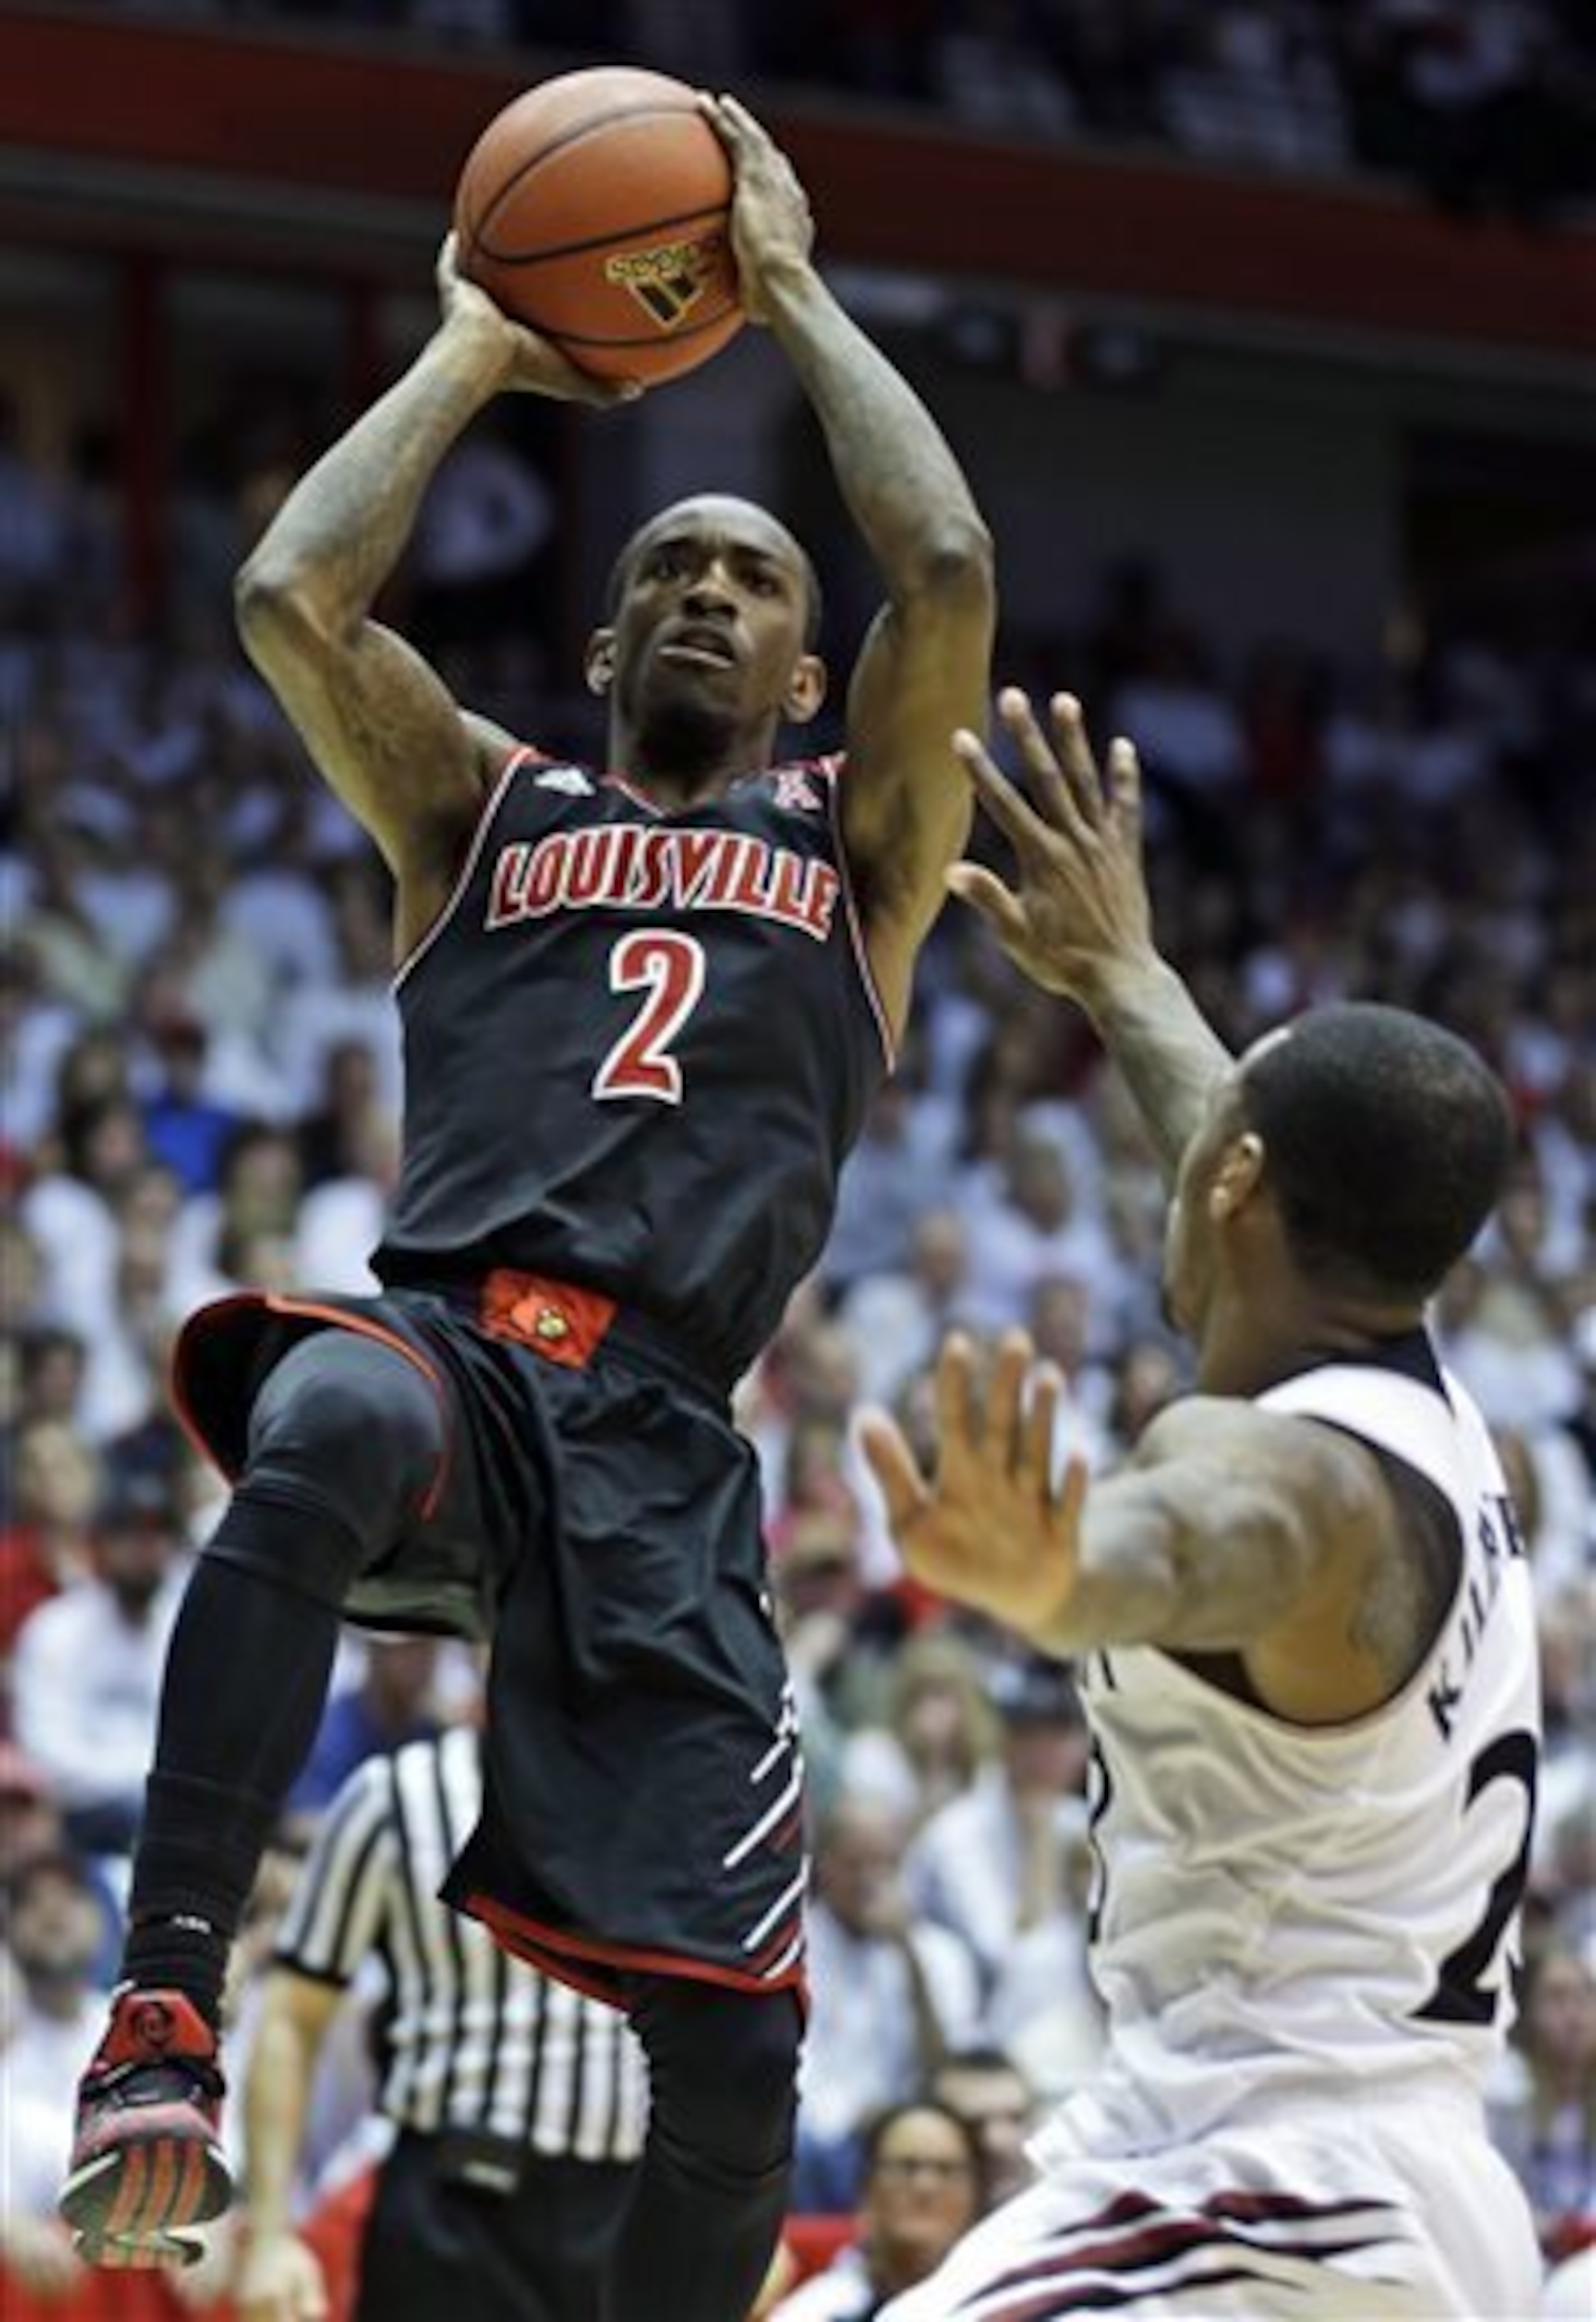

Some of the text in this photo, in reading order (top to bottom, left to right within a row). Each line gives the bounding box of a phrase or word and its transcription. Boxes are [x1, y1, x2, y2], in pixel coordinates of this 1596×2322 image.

[484, 824, 840, 941] LOUISVILLE
[592, 929, 705, 1104] 2
[1406, 1728, 1537, 2026] 2
